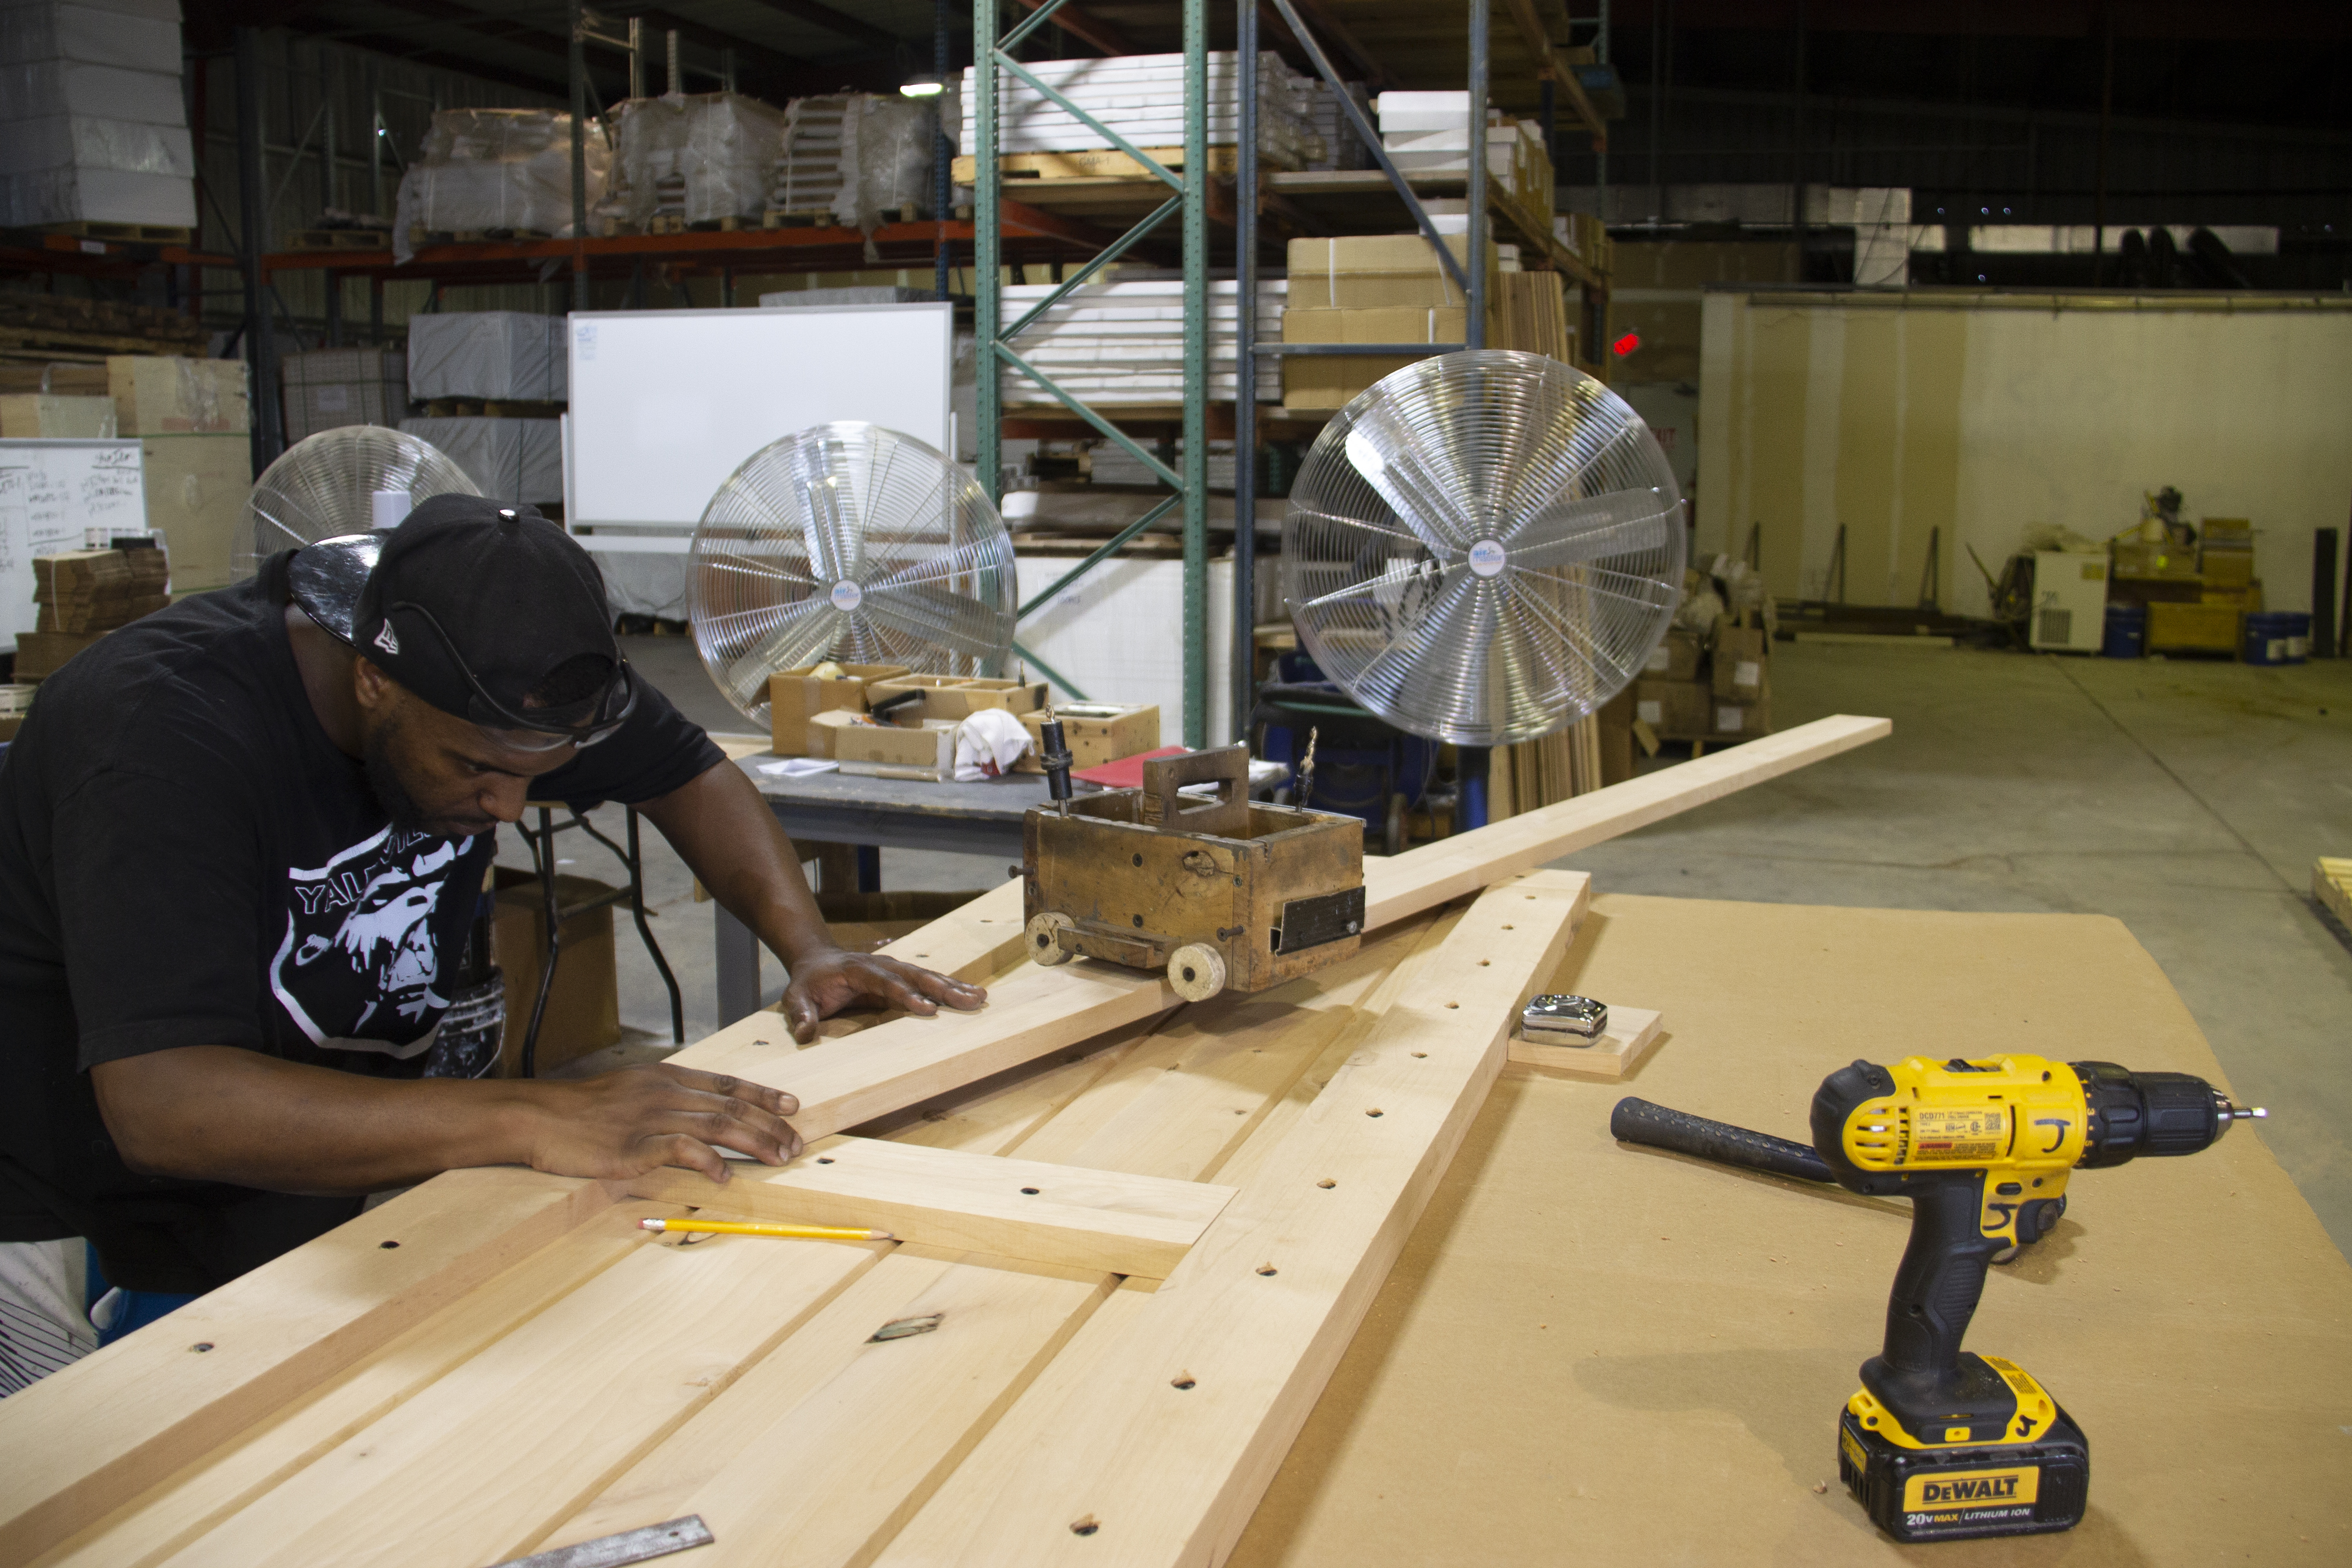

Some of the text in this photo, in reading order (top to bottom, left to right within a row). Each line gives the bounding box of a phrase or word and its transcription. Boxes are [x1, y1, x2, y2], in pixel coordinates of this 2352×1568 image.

[1934, 1513, 1960, 1523] MAX
[1964, 1509, 2008, 1521] LITHIUM
[2011, 1508, 2030, 1517] ION
